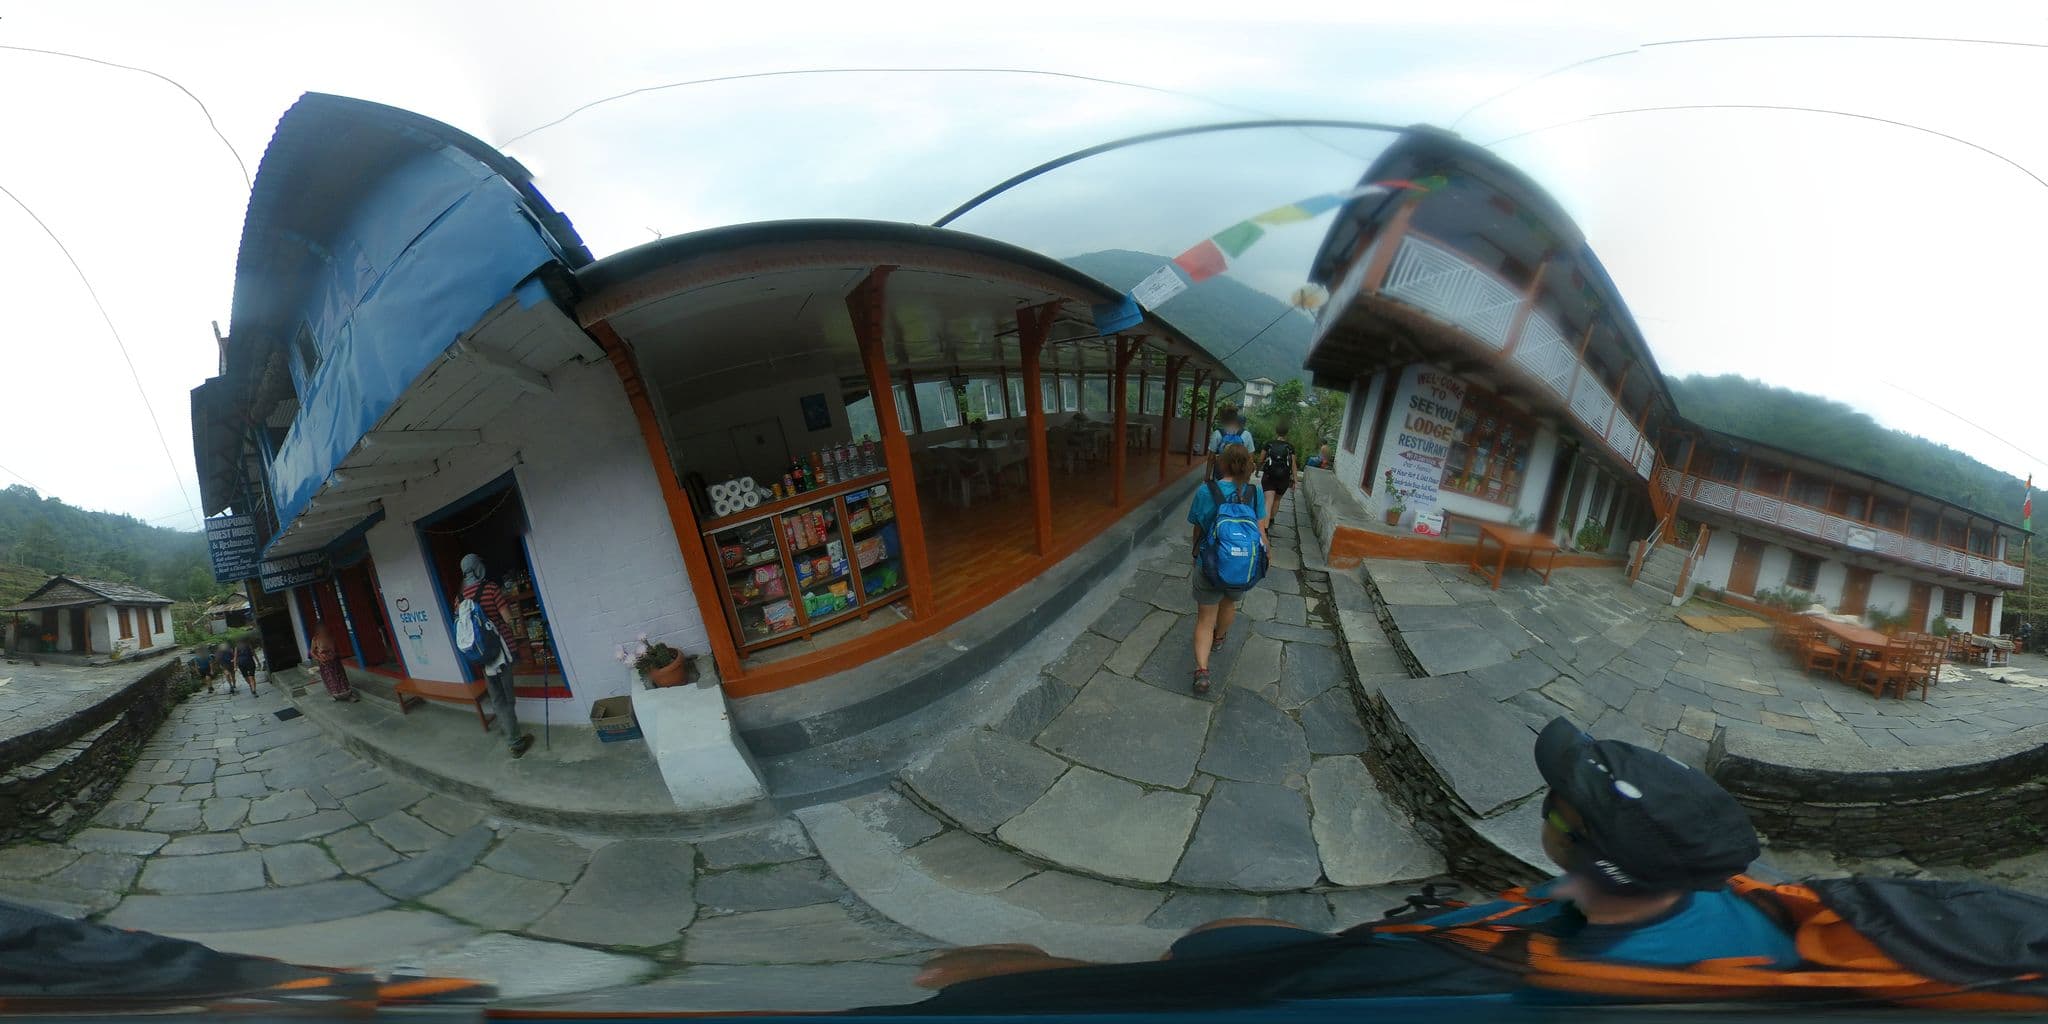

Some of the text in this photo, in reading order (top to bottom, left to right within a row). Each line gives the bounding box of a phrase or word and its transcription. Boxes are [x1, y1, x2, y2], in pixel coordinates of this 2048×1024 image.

[1431, 386, 1447, 400] TO
[1404, 412, 1453, 441] LODGE
[208, 526, 256, 541] GUEST HOUSE
[263, 576, 285, 590] HOUSE
[400, 610, 428, 623] SERVICE
